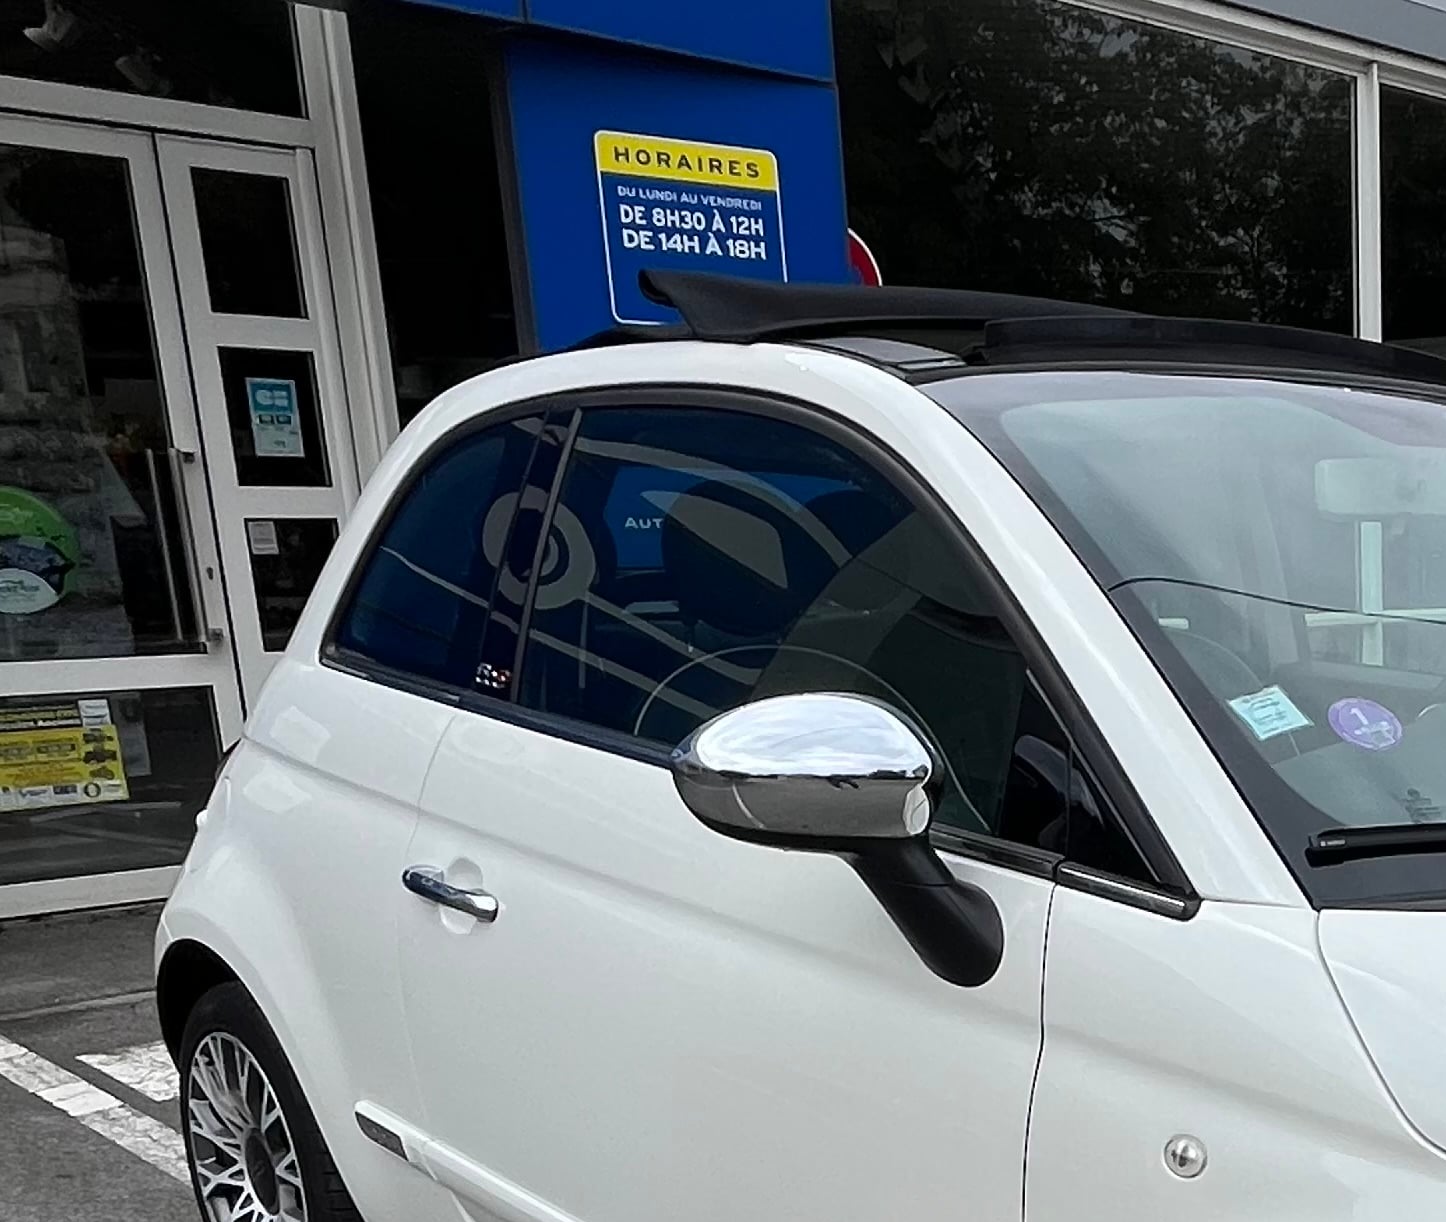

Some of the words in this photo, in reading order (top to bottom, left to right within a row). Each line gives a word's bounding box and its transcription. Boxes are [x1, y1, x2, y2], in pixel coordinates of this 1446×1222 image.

[613, 146, 760, 178] HORAIRES
[617, 185, 636, 197] DU
[638, 187, 677, 202] LUNDI
[680, 191, 699, 205] AU
[700, 194, 762, 211] VENDREDI
[619, 203, 647, 225] DE
[652, 207, 706, 231] 8H30
[711, 208, 726, 234] À
[729, 215, 764, 237] 12H
[622, 228, 656, 250] DE
[658, 233, 700, 254] 14H
[705, 231, 723, 256] À
[726, 239, 767, 260] 18H
